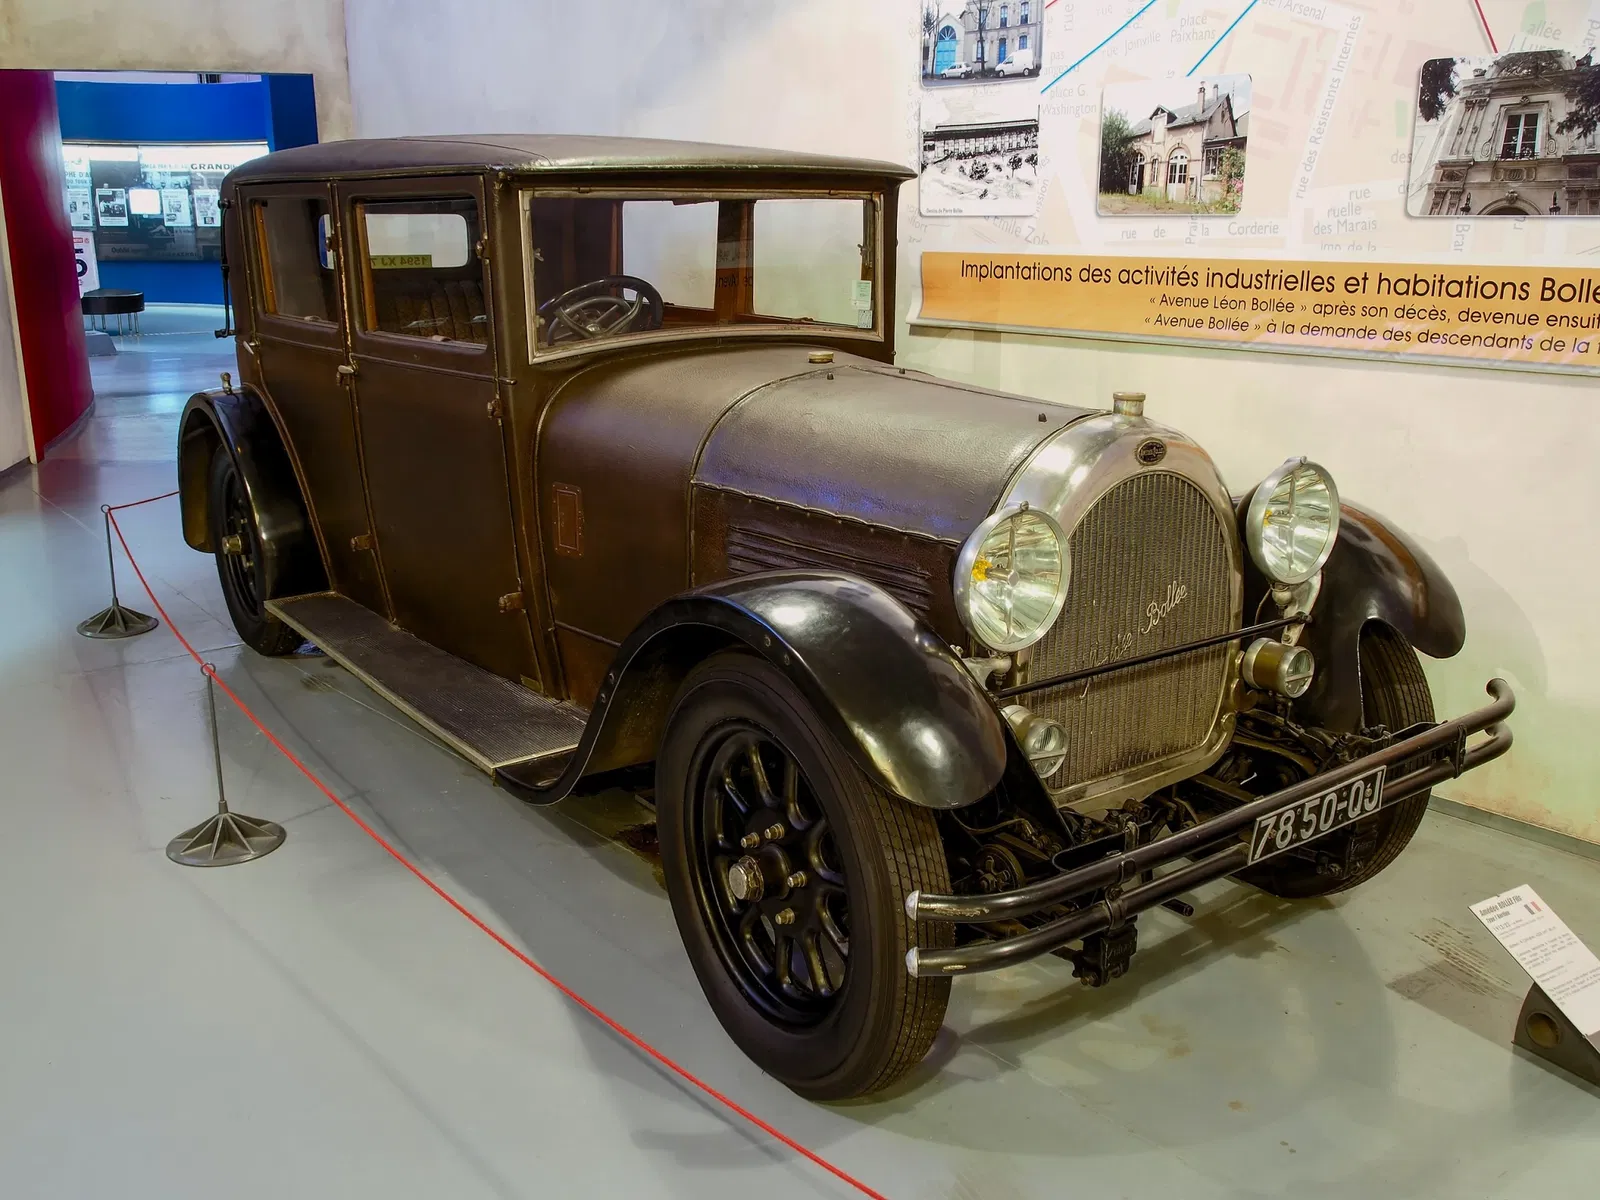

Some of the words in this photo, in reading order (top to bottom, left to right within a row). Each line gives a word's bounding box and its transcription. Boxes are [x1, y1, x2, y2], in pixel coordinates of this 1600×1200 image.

[1278, 0, 1327, 20] lArsenal
[1180, 13, 1207, 29] place
[1124, 31, 1161, 56] Joinville
[1171, 28, 1216, 43] Paixhans
[1041, 103, 1097, 118] Washington
[1296, 176, 1309, 200] rue
[1303, 150, 1318, 172] des
[1349, 187, 1371, 201] rue
[1327, 202, 1362, 218] ruelle
[1121, 228, 1137, 239] rue
[1153, 225, 1166, 238] de
[1201, 223, 1210, 237] la
[1227, 221, 1279, 236] Corderie
[1313, 220, 1332, 236] des
[1337, 217, 1377, 235] Marais
[961, 259, 1073, 282] Implantations
[1079, 263, 1111, 284] des
[1118, 264, 1199, 288] activités
[1206, 267, 1336, 293] industrielles
[1344, 272, 1369, 295] et
[1377, 272, 1531, 301] habitations
[1159, 293, 1209, 309] Avenue
[1213, 295, 1247, 311] Léon
[1251, 297, 1295, 313] Bollée
[1312, 301, 1356, 318] après
[1361, 305, 1389, 318] son
[1394, 303, 1451, 324] décès,
[1457, 307, 1540, 326] devenue
[1154, 313, 1204, 329] Avenue
[1208, 316, 1249, 332] Bollée
[1266, 318, 1277, 334] à
[1281, 321, 1295, 335] la
[1300, 322, 1378, 340] demande
[1382, 327, 1412, 342] des
[1417, 329, 1534, 350] descendants
[1540, 336, 1566, 353] de
[1572, 337, 1591, 354] la
